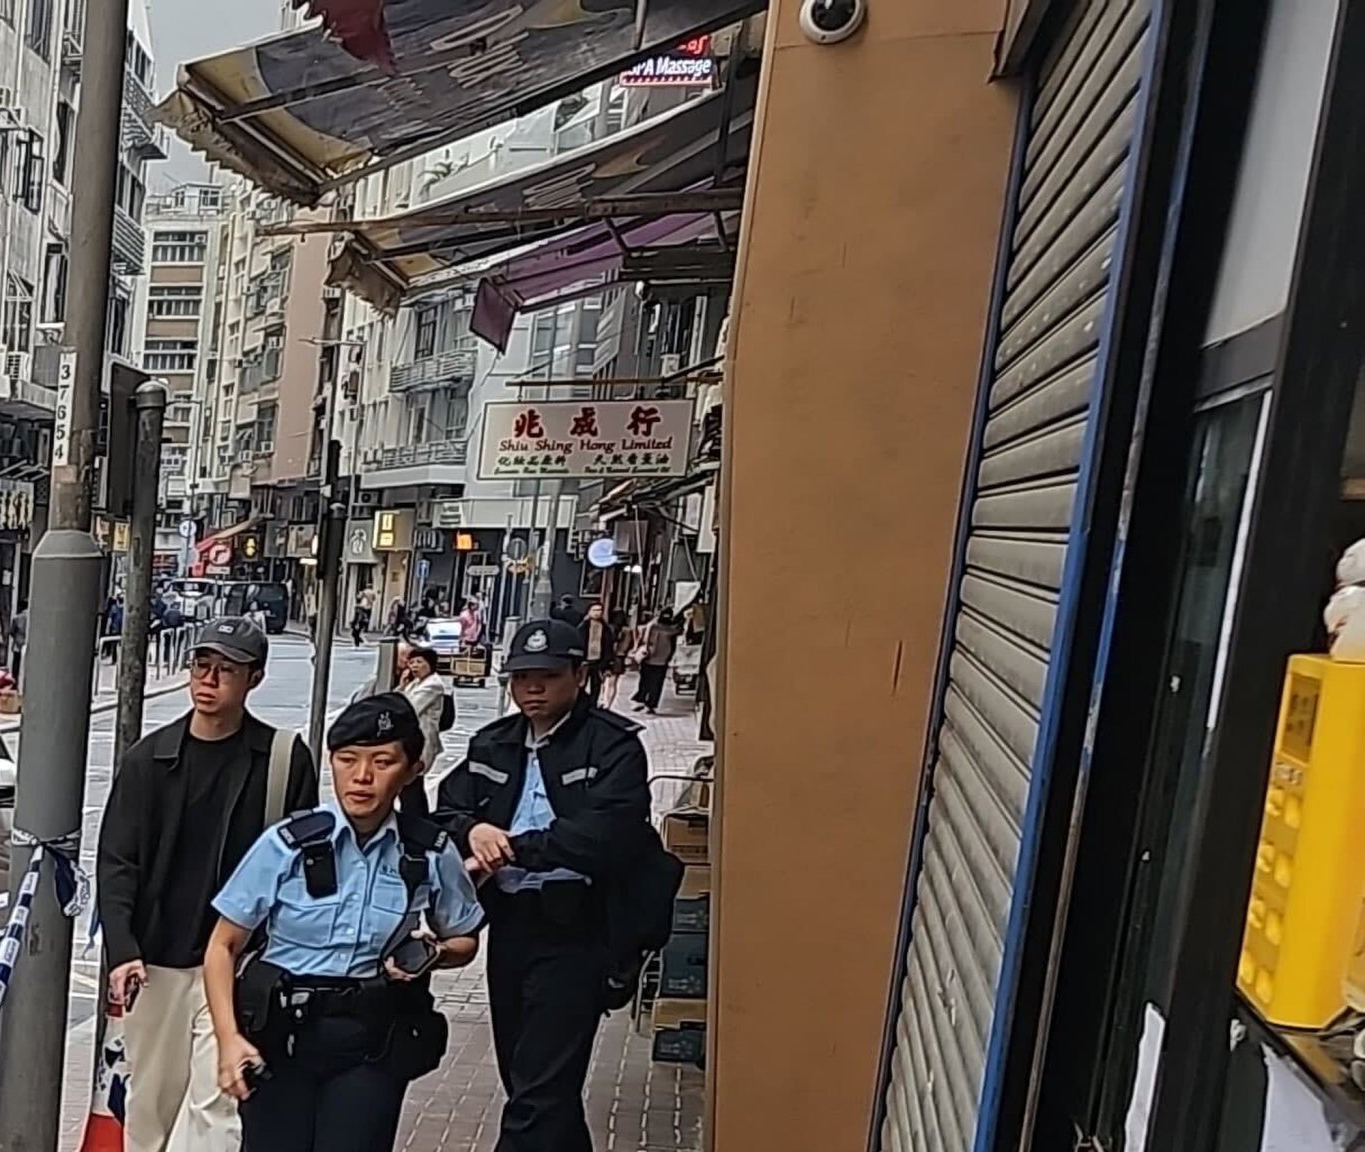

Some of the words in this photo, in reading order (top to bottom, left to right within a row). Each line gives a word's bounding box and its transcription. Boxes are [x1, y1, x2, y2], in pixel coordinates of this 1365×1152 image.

[656, 56, 711, 77] Massage
[54, 364, 71, 459] 37654
[514, 406, 661, 438] 兆成行
[499, 440, 528, 451] Shiu
[536, 440, 572, 453] Shing
[580, 440, 615, 453] Hong
[622, 437, 672, 450] Limited
